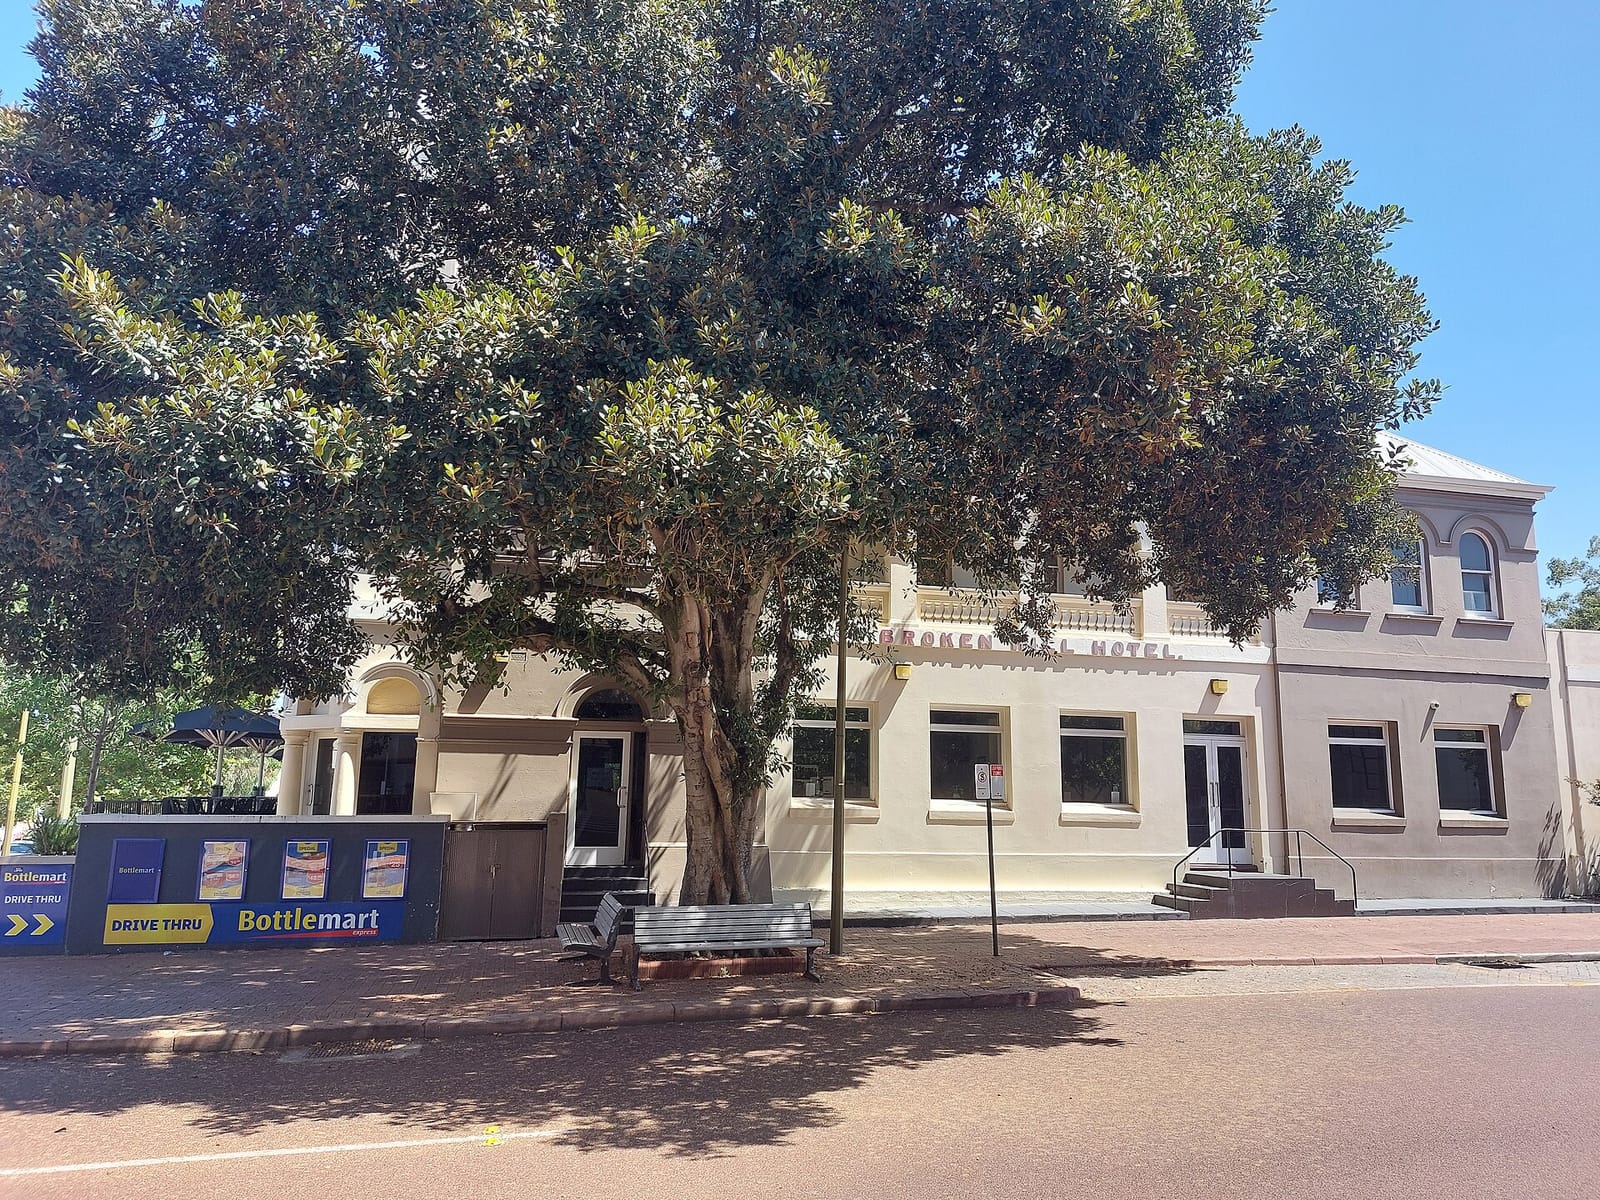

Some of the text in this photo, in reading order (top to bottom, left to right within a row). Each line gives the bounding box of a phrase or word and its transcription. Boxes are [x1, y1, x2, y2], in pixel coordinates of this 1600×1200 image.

[879, 629, 993, 650] BROKEN
[4, 871, 67, 882] Bottlemart
[4, 895, 62, 904] DRIVE THRU
[238, 907, 379, 931] Bottlemart
[112, 919, 202, 931] DRIVE THRU
[352, 929, 377, 937] express
